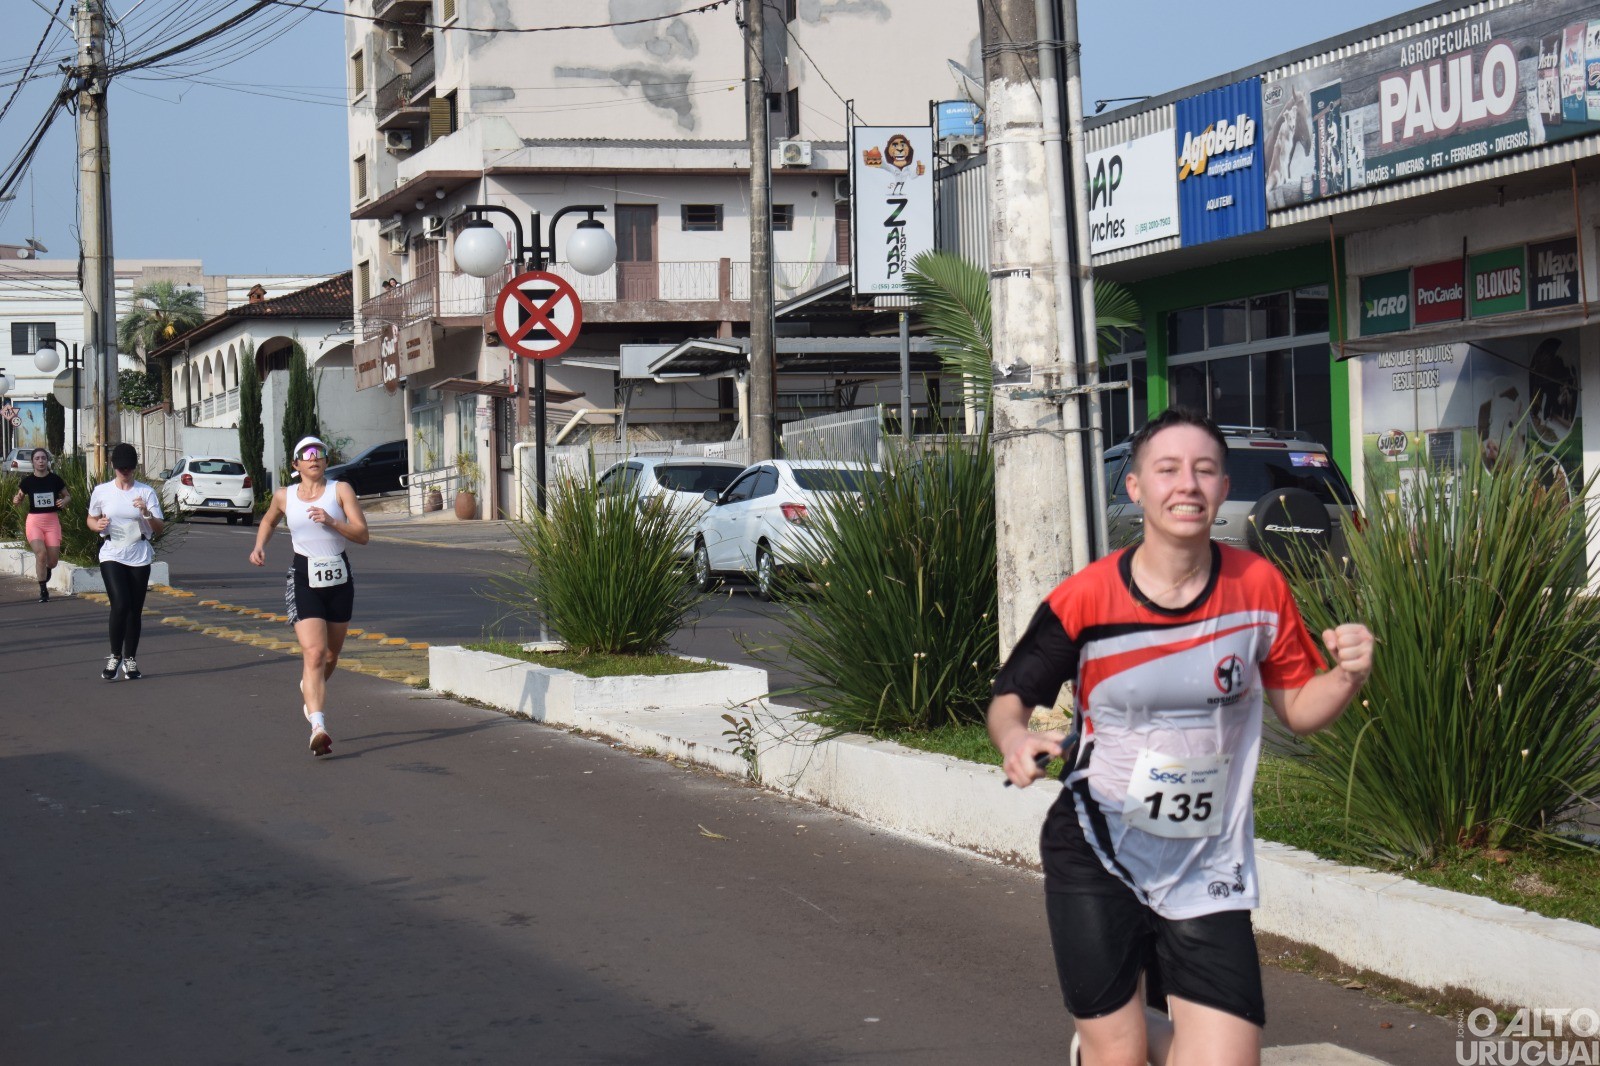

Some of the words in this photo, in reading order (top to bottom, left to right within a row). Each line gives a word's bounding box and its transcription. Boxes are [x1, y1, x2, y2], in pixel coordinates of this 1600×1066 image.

[1400, 20, 1492, 67] AGROPECUÁRIA
[1380, 43, 1517, 144] PAULO
[1179, 113, 1255, 171] AgroBella
[1366, 165, 1389, 185] RAÇÕES
[1395, 157, 1425, 177] MINERAIS
[1431, 152, 1444, 168] PET
[1450, 140, 1488, 164] FERRAGENS
[1495, 131, 1529, 153] DIVERSOS
[1418, 282, 1463, 306] ProCavalo
[1476, 267, 1521, 300] BLOKUS
[1538, 274, 1571, 301] milk
[1367, 294, 1407, 318] AGRO
[1397, 350, 1411, 367] QUE
[315, 568, 343, 582] 183
[1149, 767, 1187, 784] Sesc
[1143, 791, 1214, 823] 135
